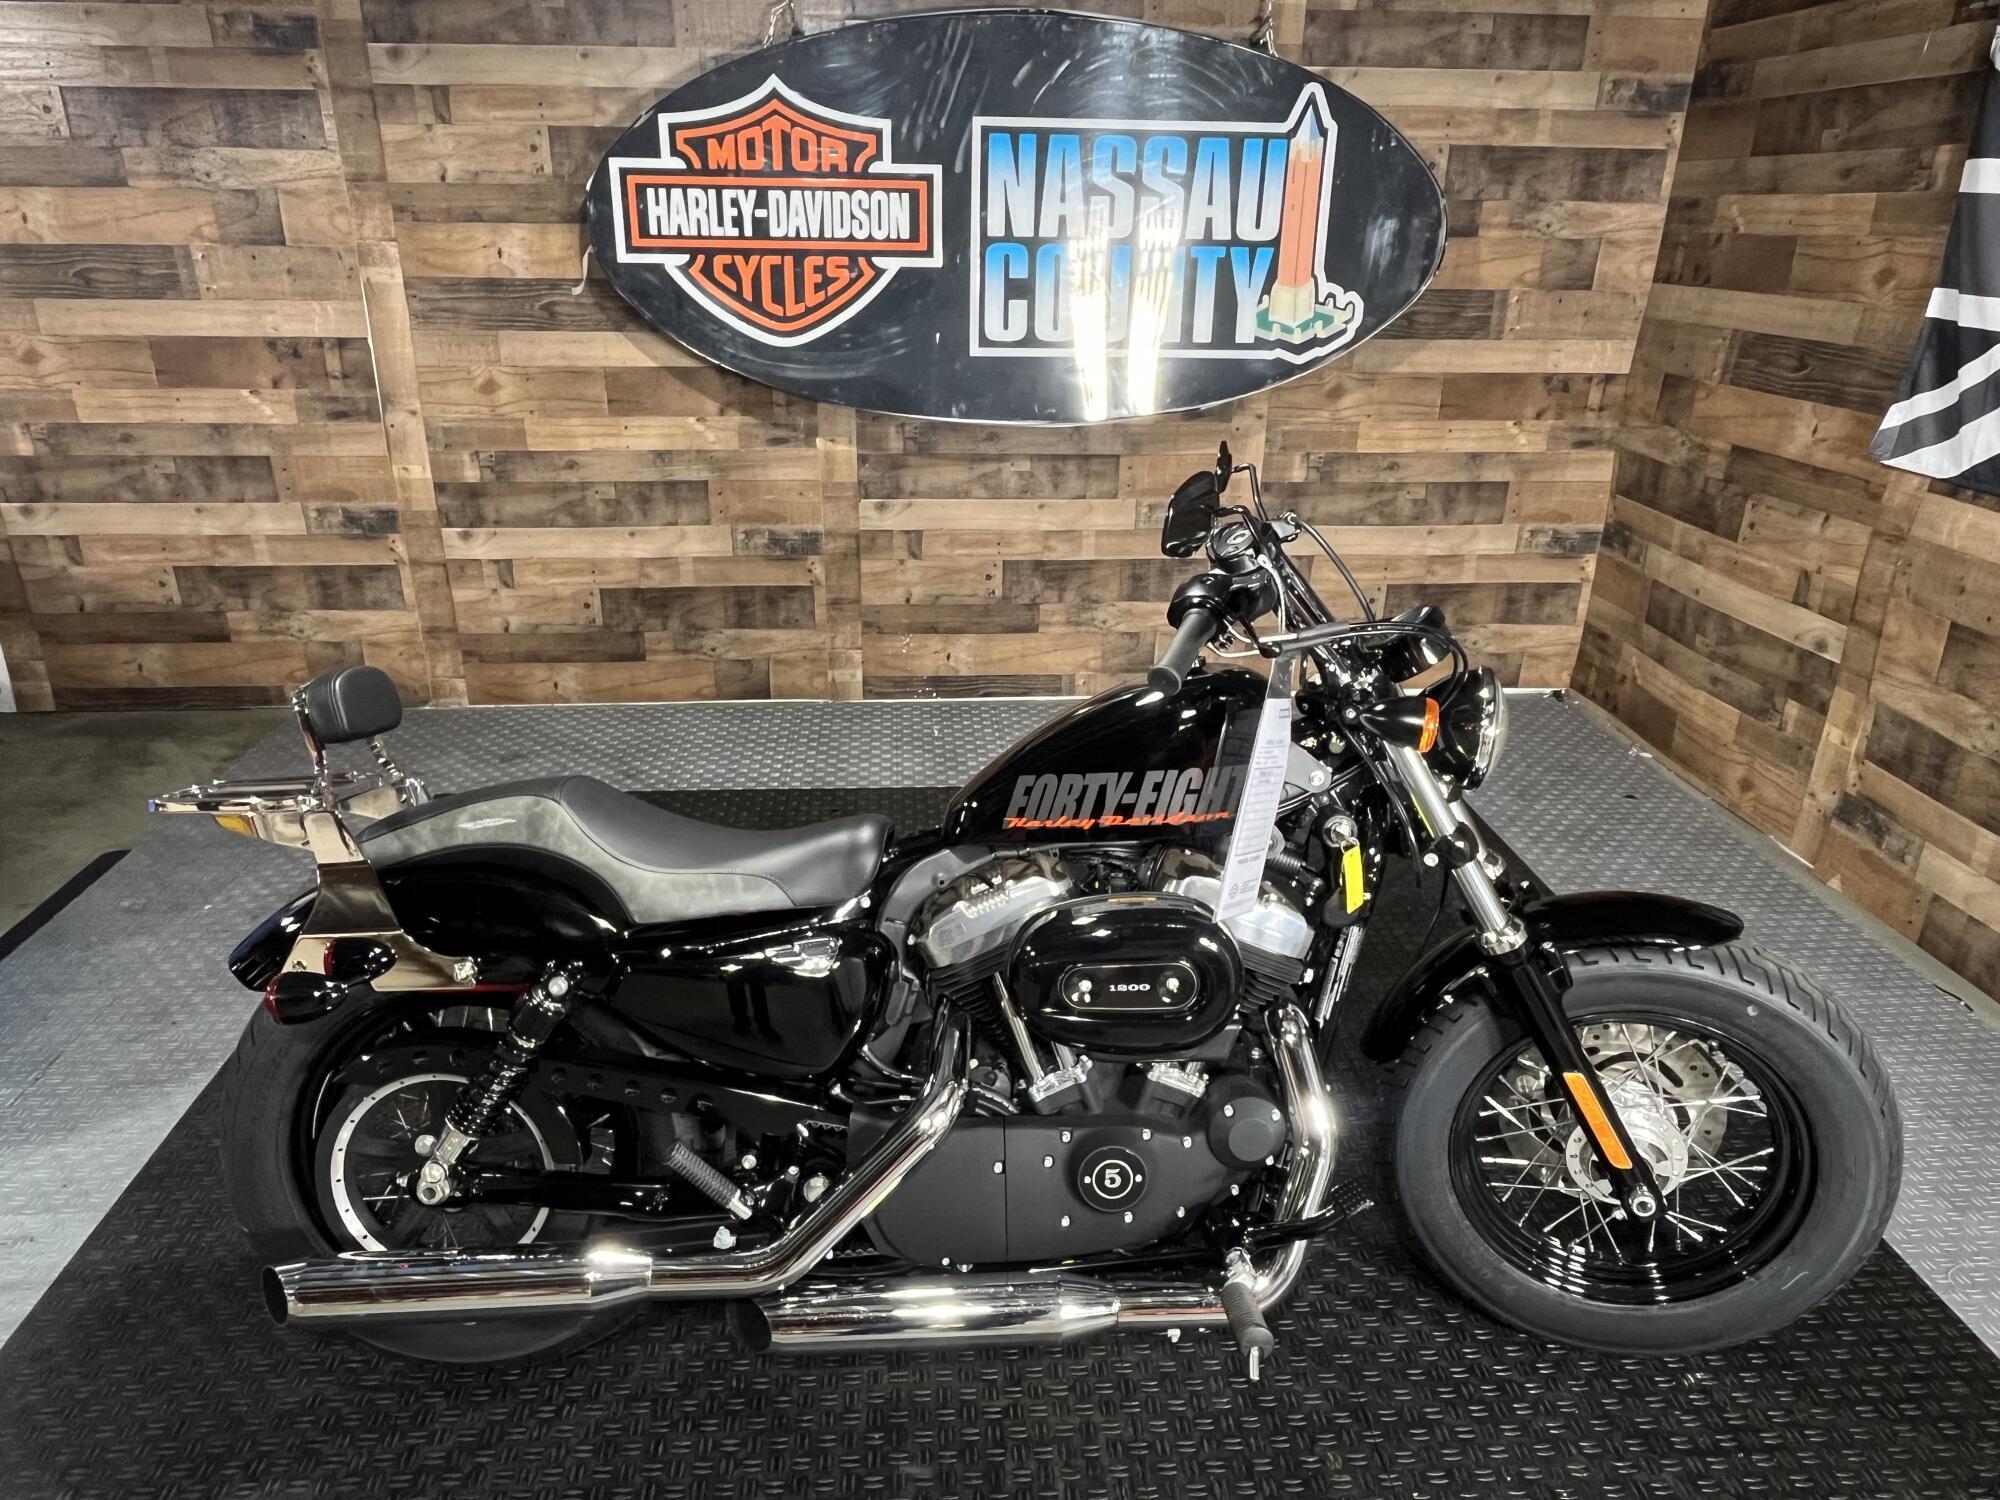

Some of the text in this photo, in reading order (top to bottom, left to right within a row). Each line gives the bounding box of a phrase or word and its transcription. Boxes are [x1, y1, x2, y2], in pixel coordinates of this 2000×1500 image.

[707, 115, 847, 172] MOTOR
[646, 187, 910, 240] HARLEY-DAVIDSON
[986, 132, 1288, 242] NASSAU
[713, 255, 850, 317] CYCLES
[1002, 764, 1249, 829] FORTY-EIGHT
[1104, 1168, 1121, 1188] 5
